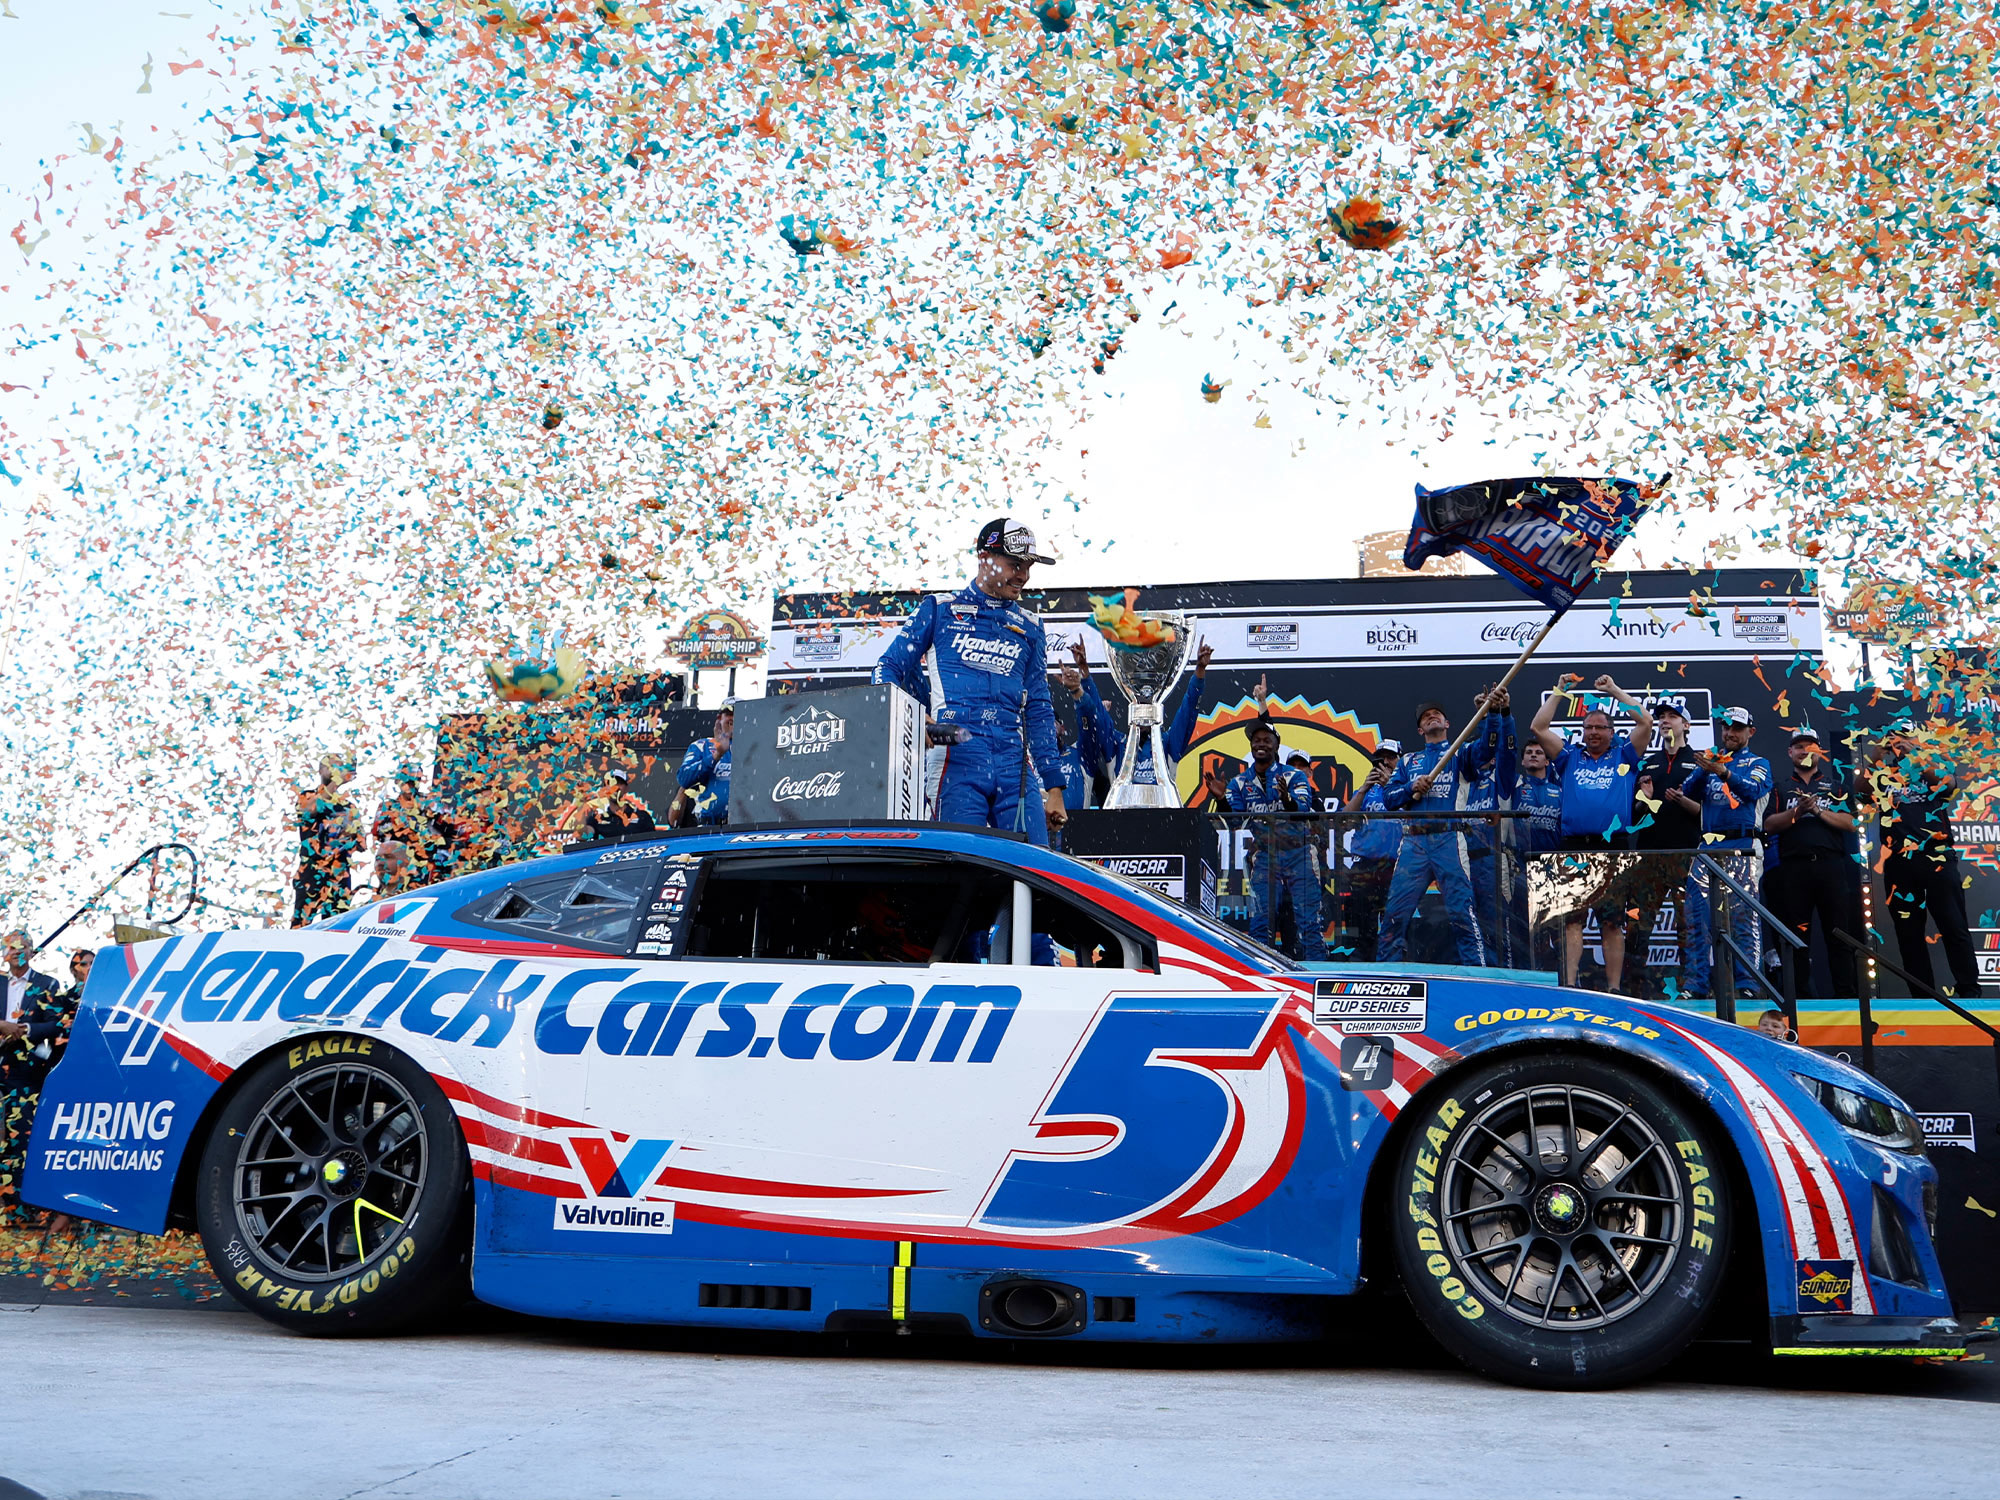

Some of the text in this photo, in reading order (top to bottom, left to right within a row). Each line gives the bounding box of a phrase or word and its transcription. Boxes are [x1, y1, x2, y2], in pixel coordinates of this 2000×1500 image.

[986, 531, 1000, 545] 5
[1750, 615, 1779, 623] NASCAR
[670, 640, 757, 654] CHAMPIONSHIP
[950, 632, 1022, 659] Hendrick
[1366, 629, 1418, 645] BUSCH
[1377, 644, 1408, 652] LIGHT
[961, 648, 1015, 671] Cars.com
[775, 718, 846, 749] BUSCH
[789, 741, 829, 756] LIGHT
[901, 702, 914, 820] CUP SERIES
[771, 770, 846, 803] Coca-Cola
[1109, 859, 1168, 875] NASCAR
[357, 926, 406, 938] Valvoline
[1350, 982, 1411, 996] NASCAR
[1329, 1000, 1411, 1013] CUP SERIES
[1345, 1022, 1422, 1032] CHAMPIONSHIP
[1454, 1006, 1661, 1041] GOODYEAR
[287, 1034, 377, 1070] EAGLE
[1352, 1044, 1382, 1081] 4
[49, 1100, 176, 1141] HIRING
[967, 990, 1294, 1237] 5
[1921, 1117, 1956, 1133] SCAR
[43, 1149, 165, 1172] TECHNICIANS
[1408, 1097, 1486, 1320] GOODYEAR
[1675, 1139, 1716, 1256] EAGLE
[561, 1203, 665, 1228] Valvoline
[235, 1236, 416, 1315] GOODYEAR
[1800, 1280, 1850, 1295] SUNOCO
